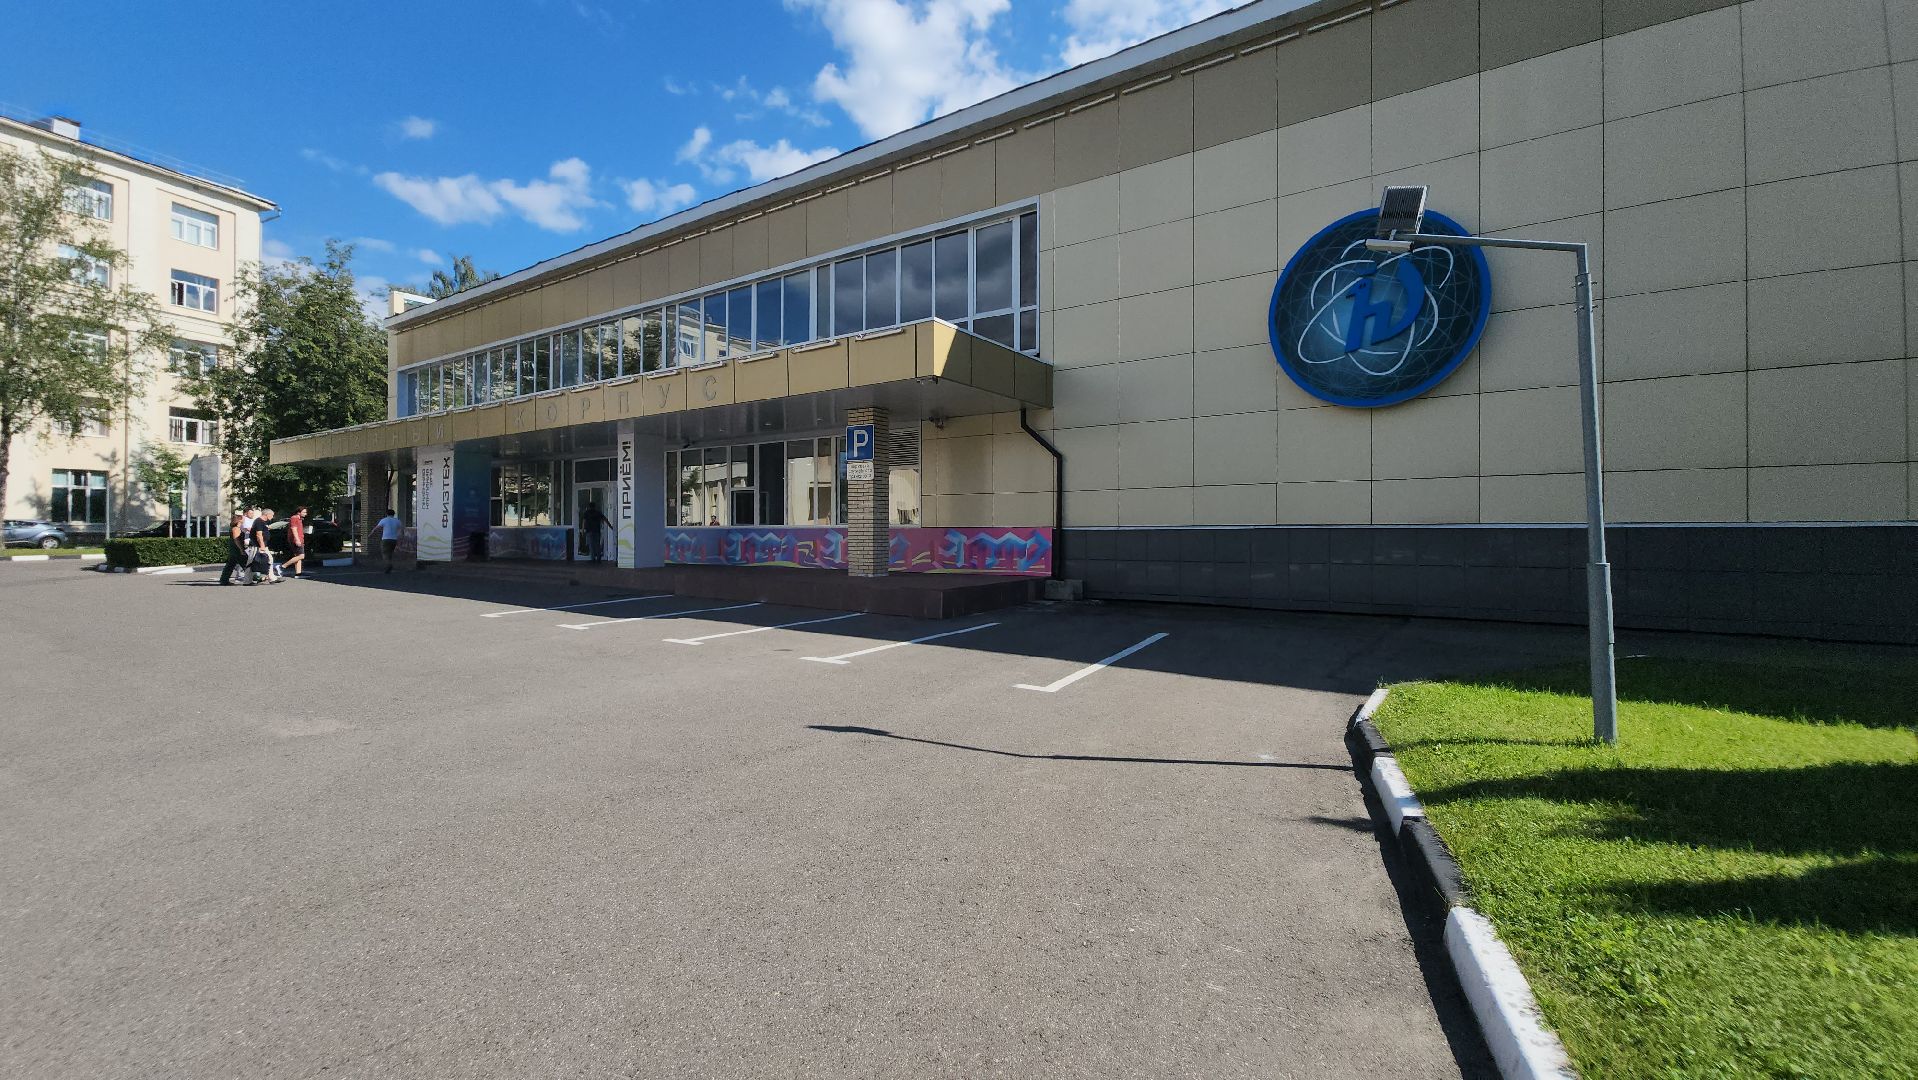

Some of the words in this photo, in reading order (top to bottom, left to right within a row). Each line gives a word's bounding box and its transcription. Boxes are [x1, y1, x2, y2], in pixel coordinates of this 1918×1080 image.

[514, 375, 718, 427] КОРПУС
[853, 430, 868, 457] P
[442, 457, 450, 528] ФИЗТЕХ
